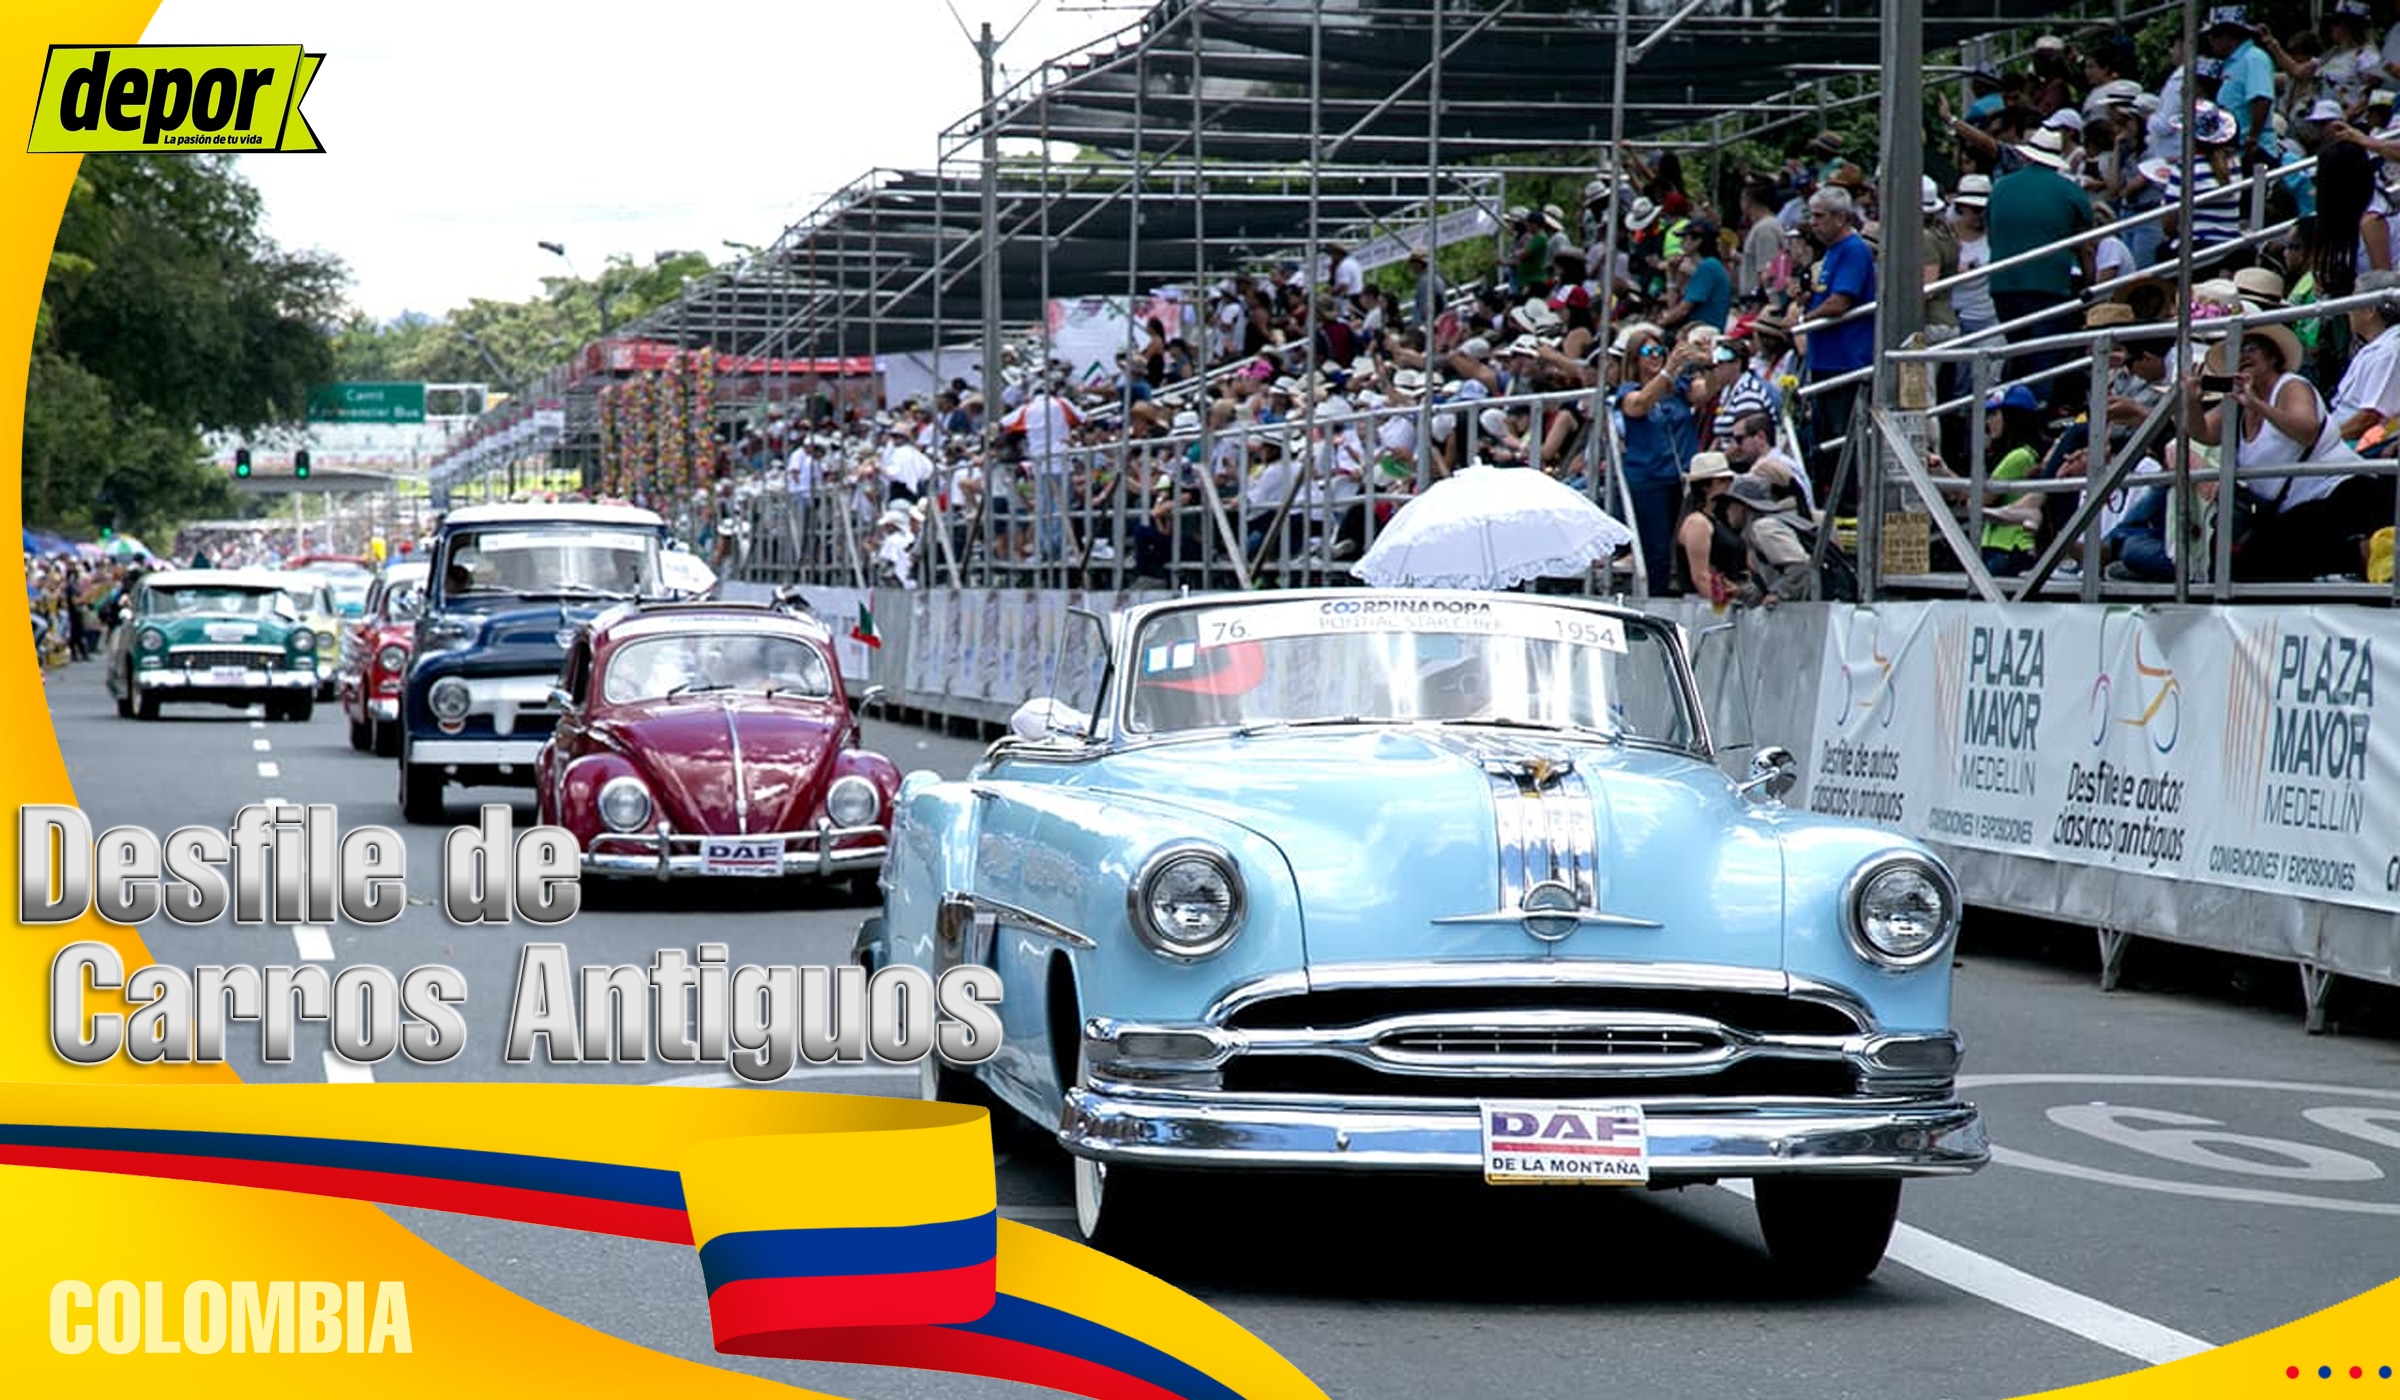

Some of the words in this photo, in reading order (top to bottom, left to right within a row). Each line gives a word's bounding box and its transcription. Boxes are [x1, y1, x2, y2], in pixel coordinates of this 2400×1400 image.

[1554, 619, 1616, 648] 1954
[1969, 626, 2045, 687] PLAZA
[2276, 633, 2374, 707] PLAZA
[1964, 688, 2041, 751] MAYOR
[2269, 706, 2370, 780] MAYOR
[2263, 781, 2364, 834] MEDELLÍN
[708, 845, 778, 859] DAF
[1491, 1112, 1640, 1141] DAF
[1493, 1157, 1516, 1171] DE
[1522, 1158, 1545, 1172] LA
[1551, 1159, 1641, 1176] MONTAÑA
